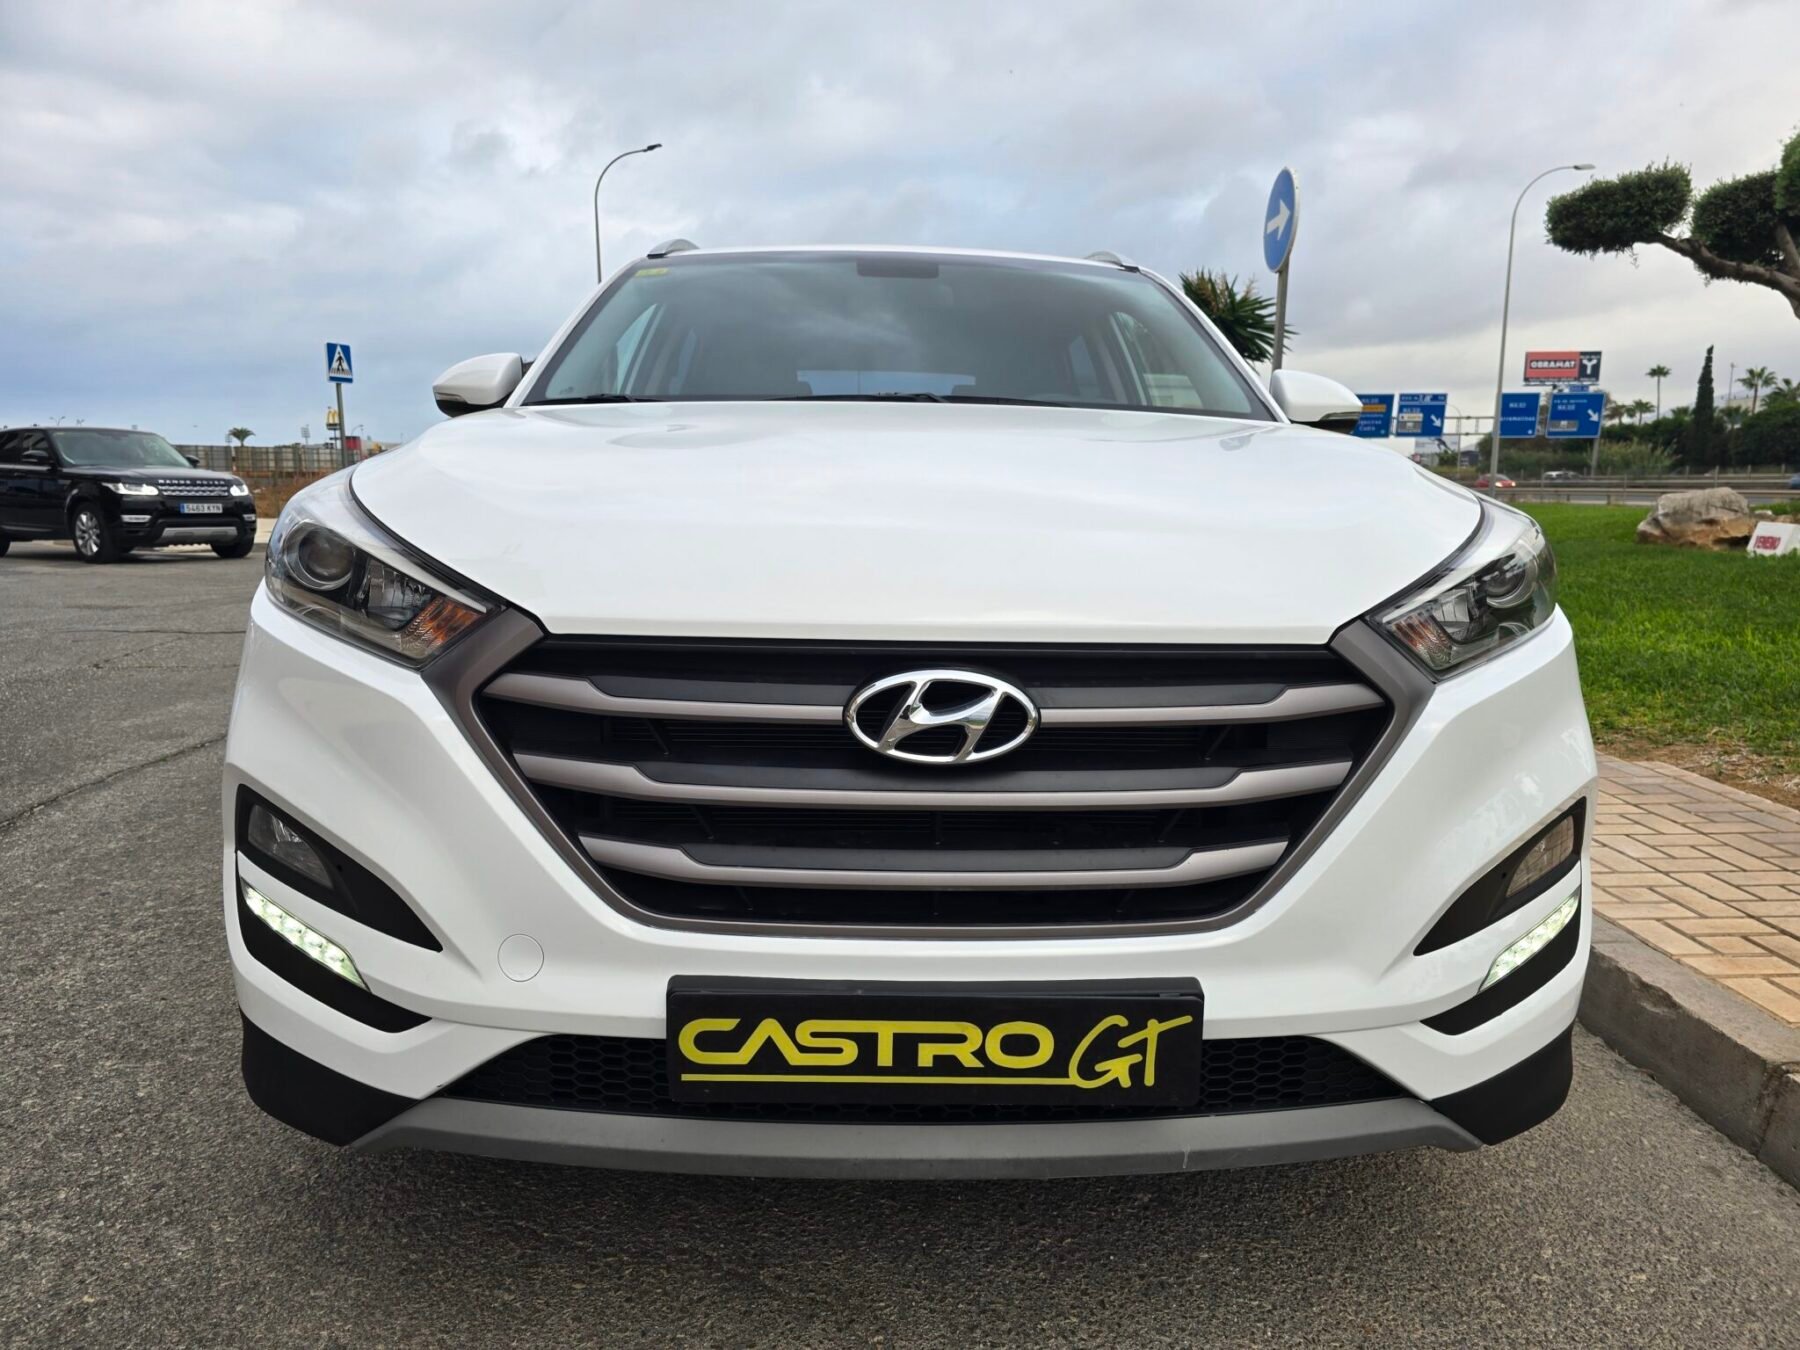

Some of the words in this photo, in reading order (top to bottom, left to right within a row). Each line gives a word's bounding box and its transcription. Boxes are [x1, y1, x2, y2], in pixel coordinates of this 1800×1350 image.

[1531, 361, 1575, 369] OBRAMAT
[678, 1017, 1055, 1069] CASTRO
[1068, 1014, 1194, 1089] GT
